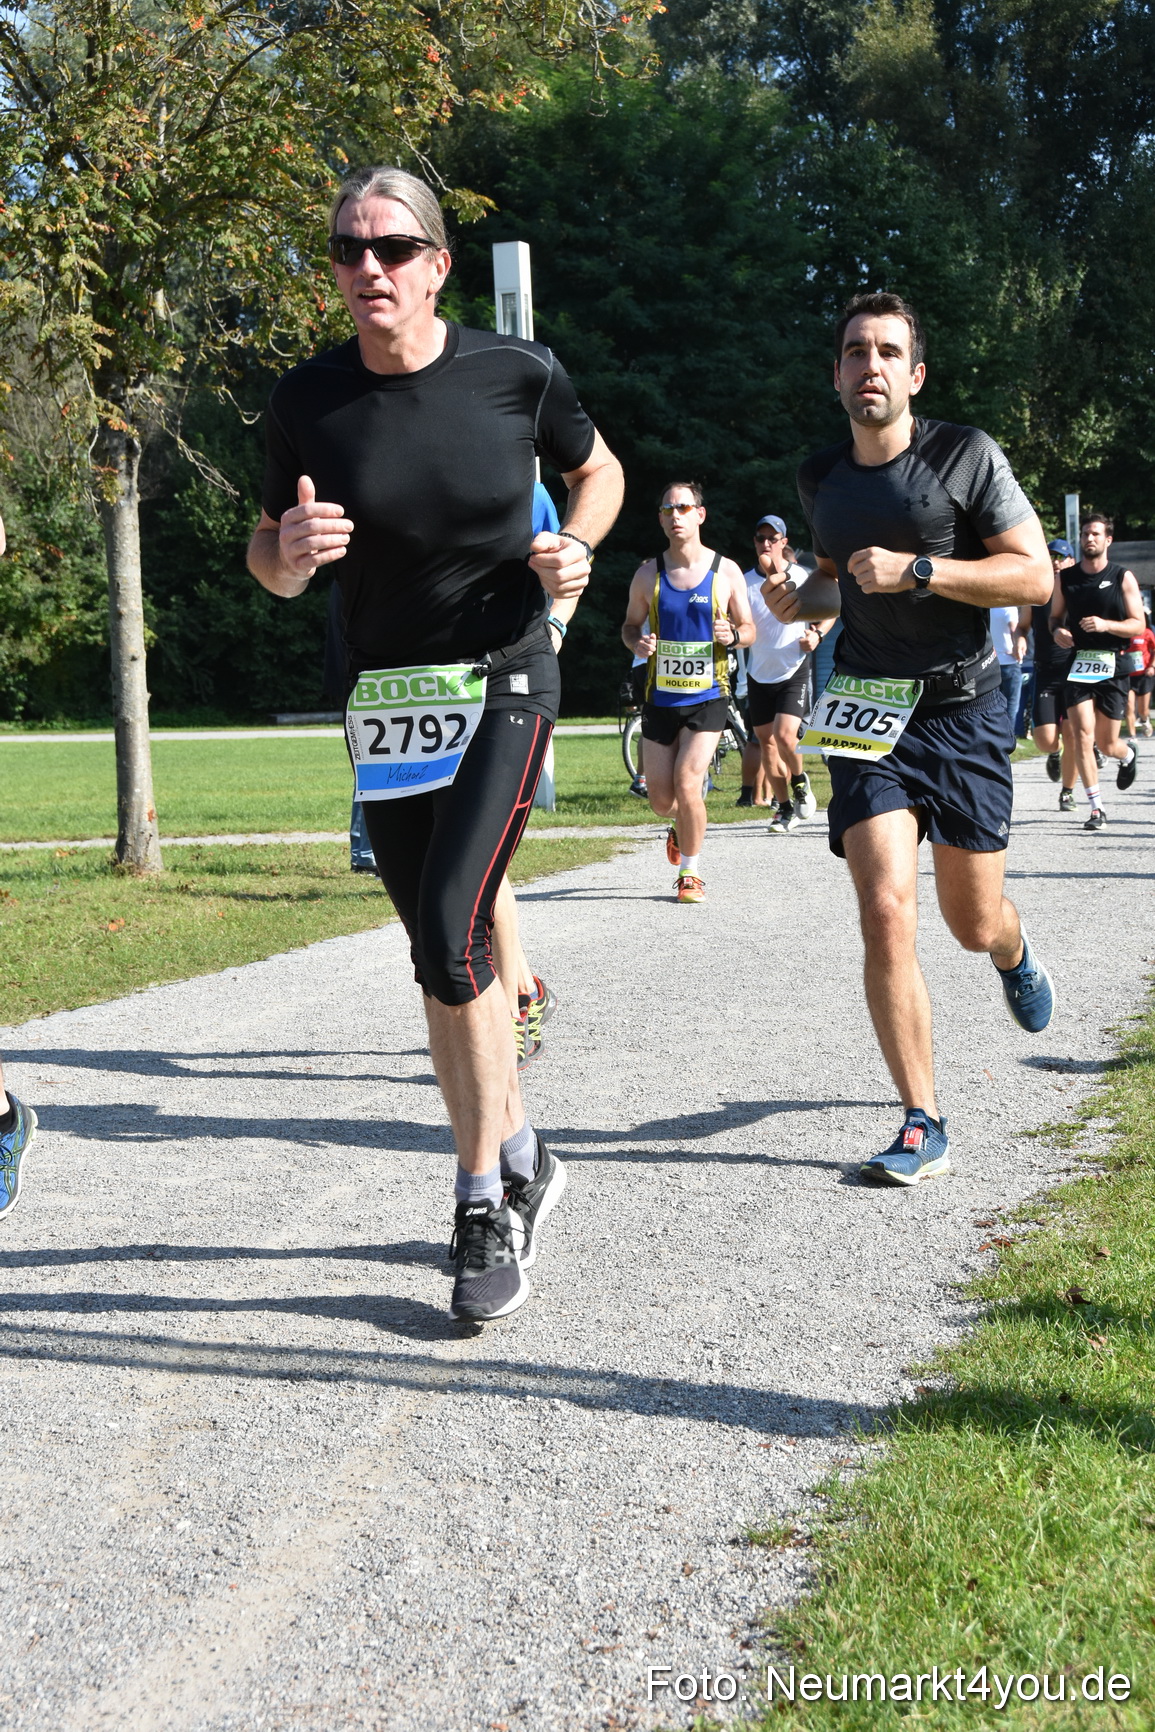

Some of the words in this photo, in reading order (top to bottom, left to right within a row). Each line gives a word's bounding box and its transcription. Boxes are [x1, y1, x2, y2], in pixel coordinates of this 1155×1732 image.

[661, 642, 707, 656] BOCK
[663, 659, 705, 676] 1203
[1075, 662, 1109, 674] 2784
[354, 671, 472, 706] BOCK
[665, 680, 701, 688] HOLGER
[830, 675, 911, 705] BOCK
[824, 700, 900, 735] 1305
[363, 713, 467, 756] 2792
